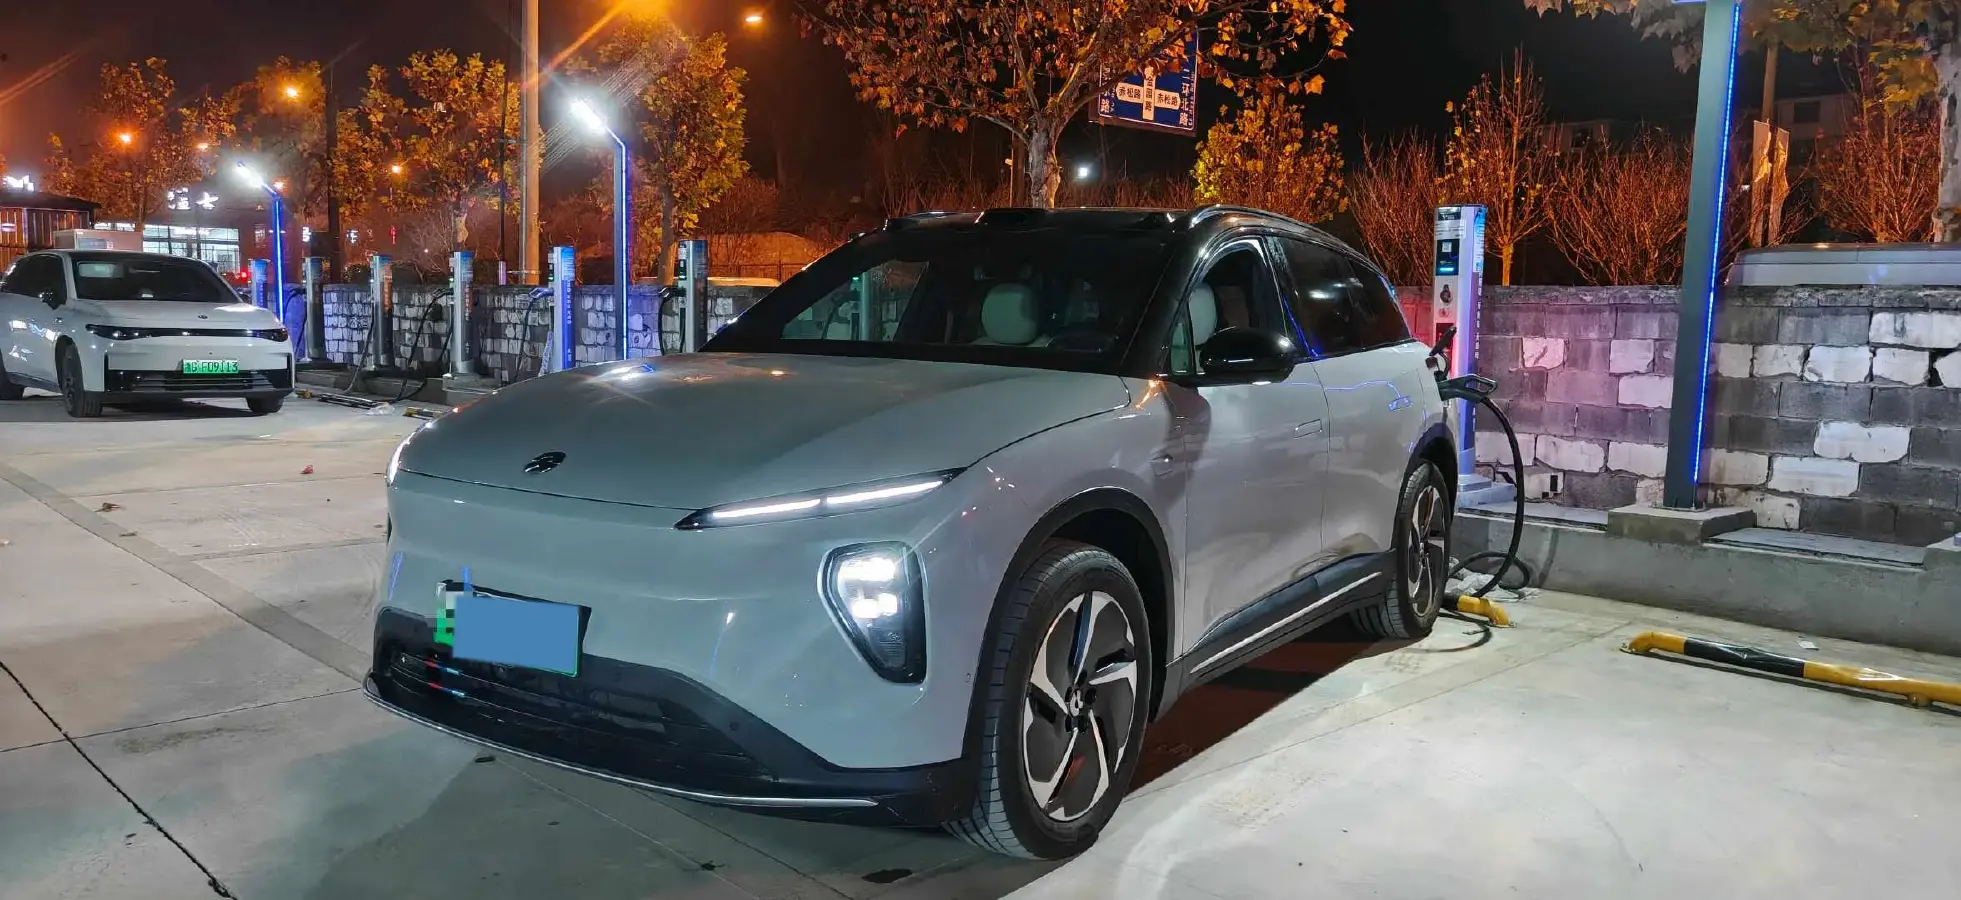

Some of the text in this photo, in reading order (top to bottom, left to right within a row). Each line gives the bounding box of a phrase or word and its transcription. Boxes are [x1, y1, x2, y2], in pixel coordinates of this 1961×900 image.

[1118, 86, 1141, 99] 赤松路
[1157, 92, 1178, 106] 赤松路
